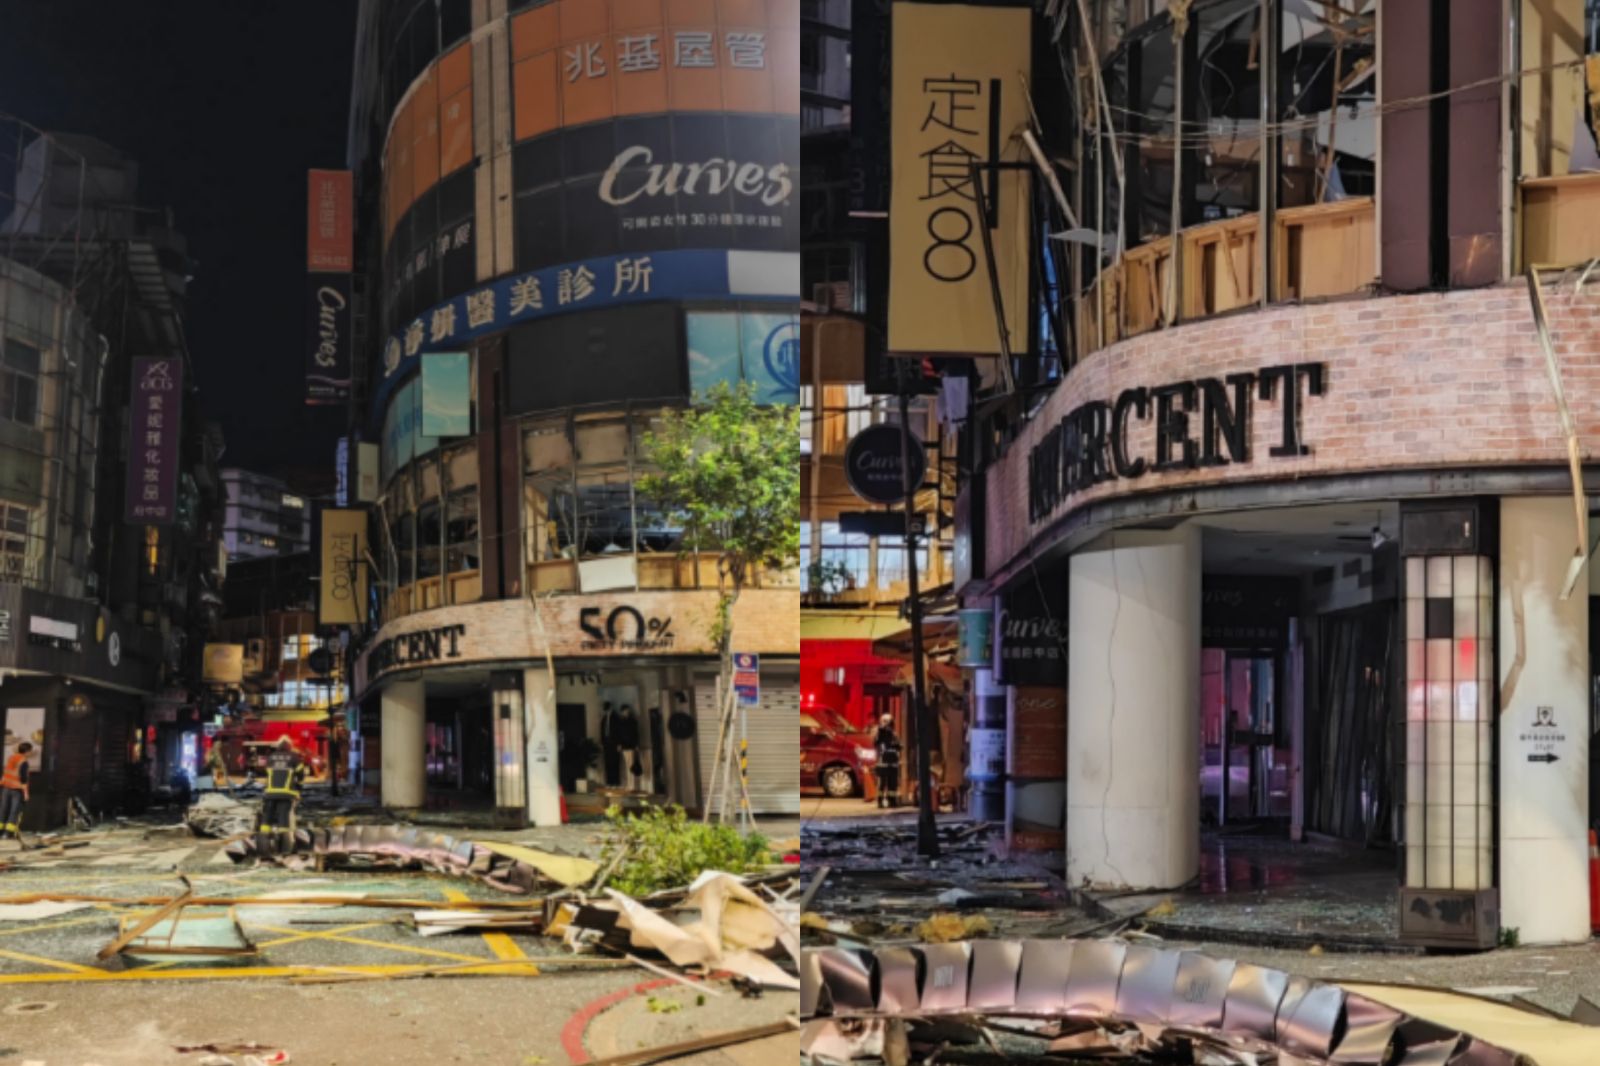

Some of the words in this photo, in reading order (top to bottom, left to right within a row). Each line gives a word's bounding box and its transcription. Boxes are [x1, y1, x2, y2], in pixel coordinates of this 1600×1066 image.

[565, 31, 766, 82] 兆基屋管
[600, 146, 792, 206] Curves
[918, 73, 987, 282] 定食8
[315, 286, 346, 368] Curves
[579, 605, 676, 641] 50%
